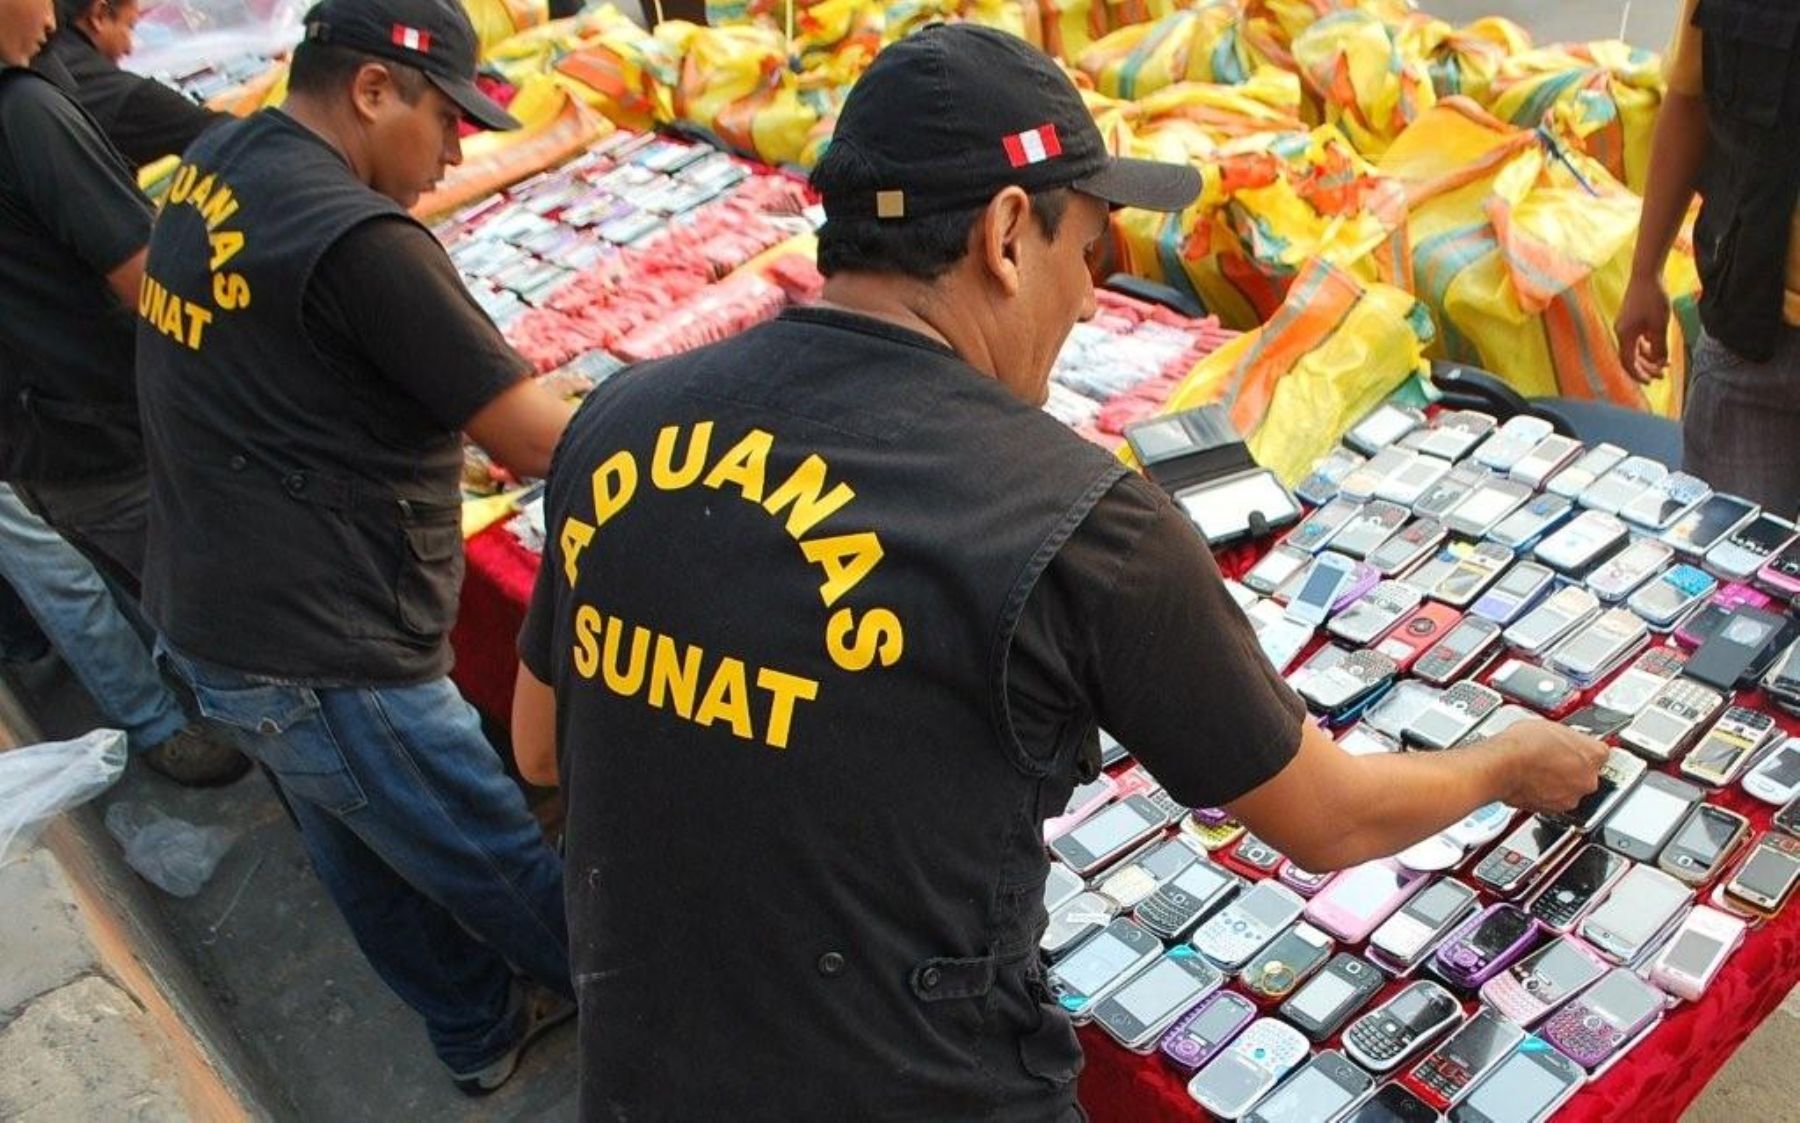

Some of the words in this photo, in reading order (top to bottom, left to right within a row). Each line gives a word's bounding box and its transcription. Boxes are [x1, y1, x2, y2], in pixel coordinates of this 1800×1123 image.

[161, 164, 250, 310] UANAS
[138, 271, 213, 350] UNAT
[560, 420, 904, 672] ADUANAS
[573, 604, 818, 749] SUNAT
